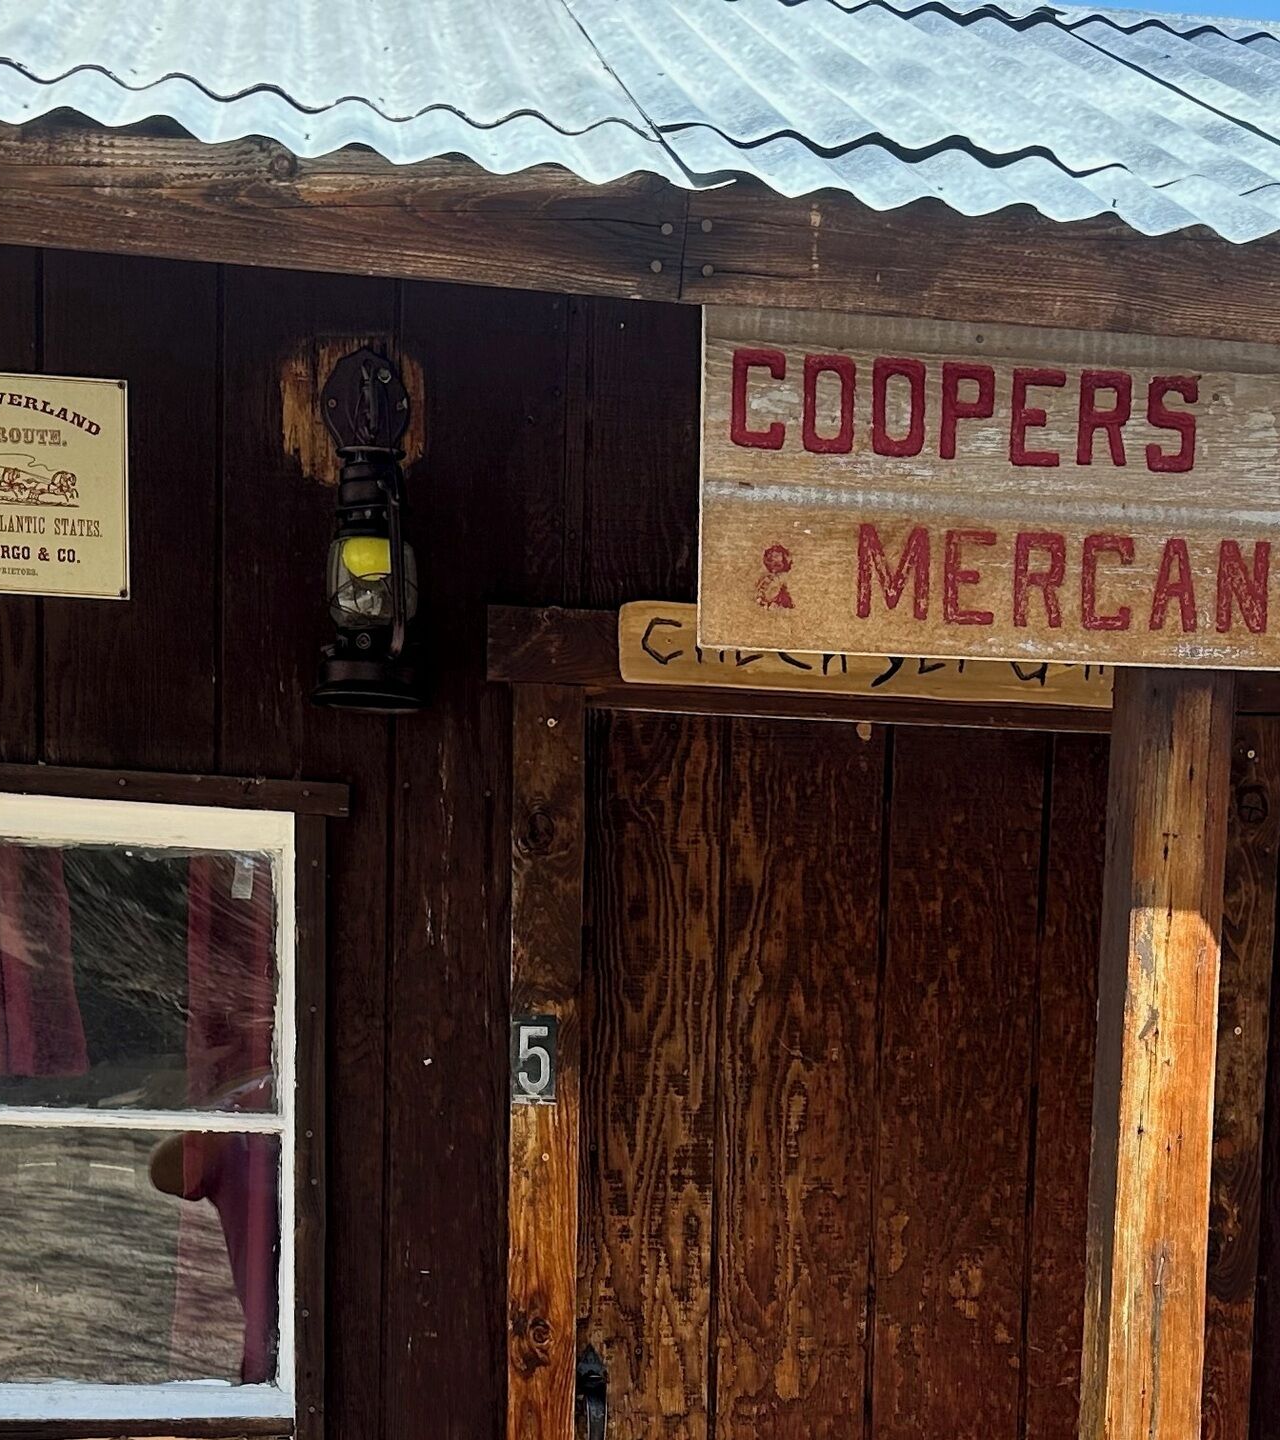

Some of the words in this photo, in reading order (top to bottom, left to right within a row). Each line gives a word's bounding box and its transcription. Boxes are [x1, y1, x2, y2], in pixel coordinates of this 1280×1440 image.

[730, 347, 1201, 473] COOPERS
[37, 547, 51, 562] &
[57, 548, 81, 563] CO.
[54, 517, 103, 537] STATES.
[755, 542, 796, 609] &
[518, 1026, 550, 1096] 5
